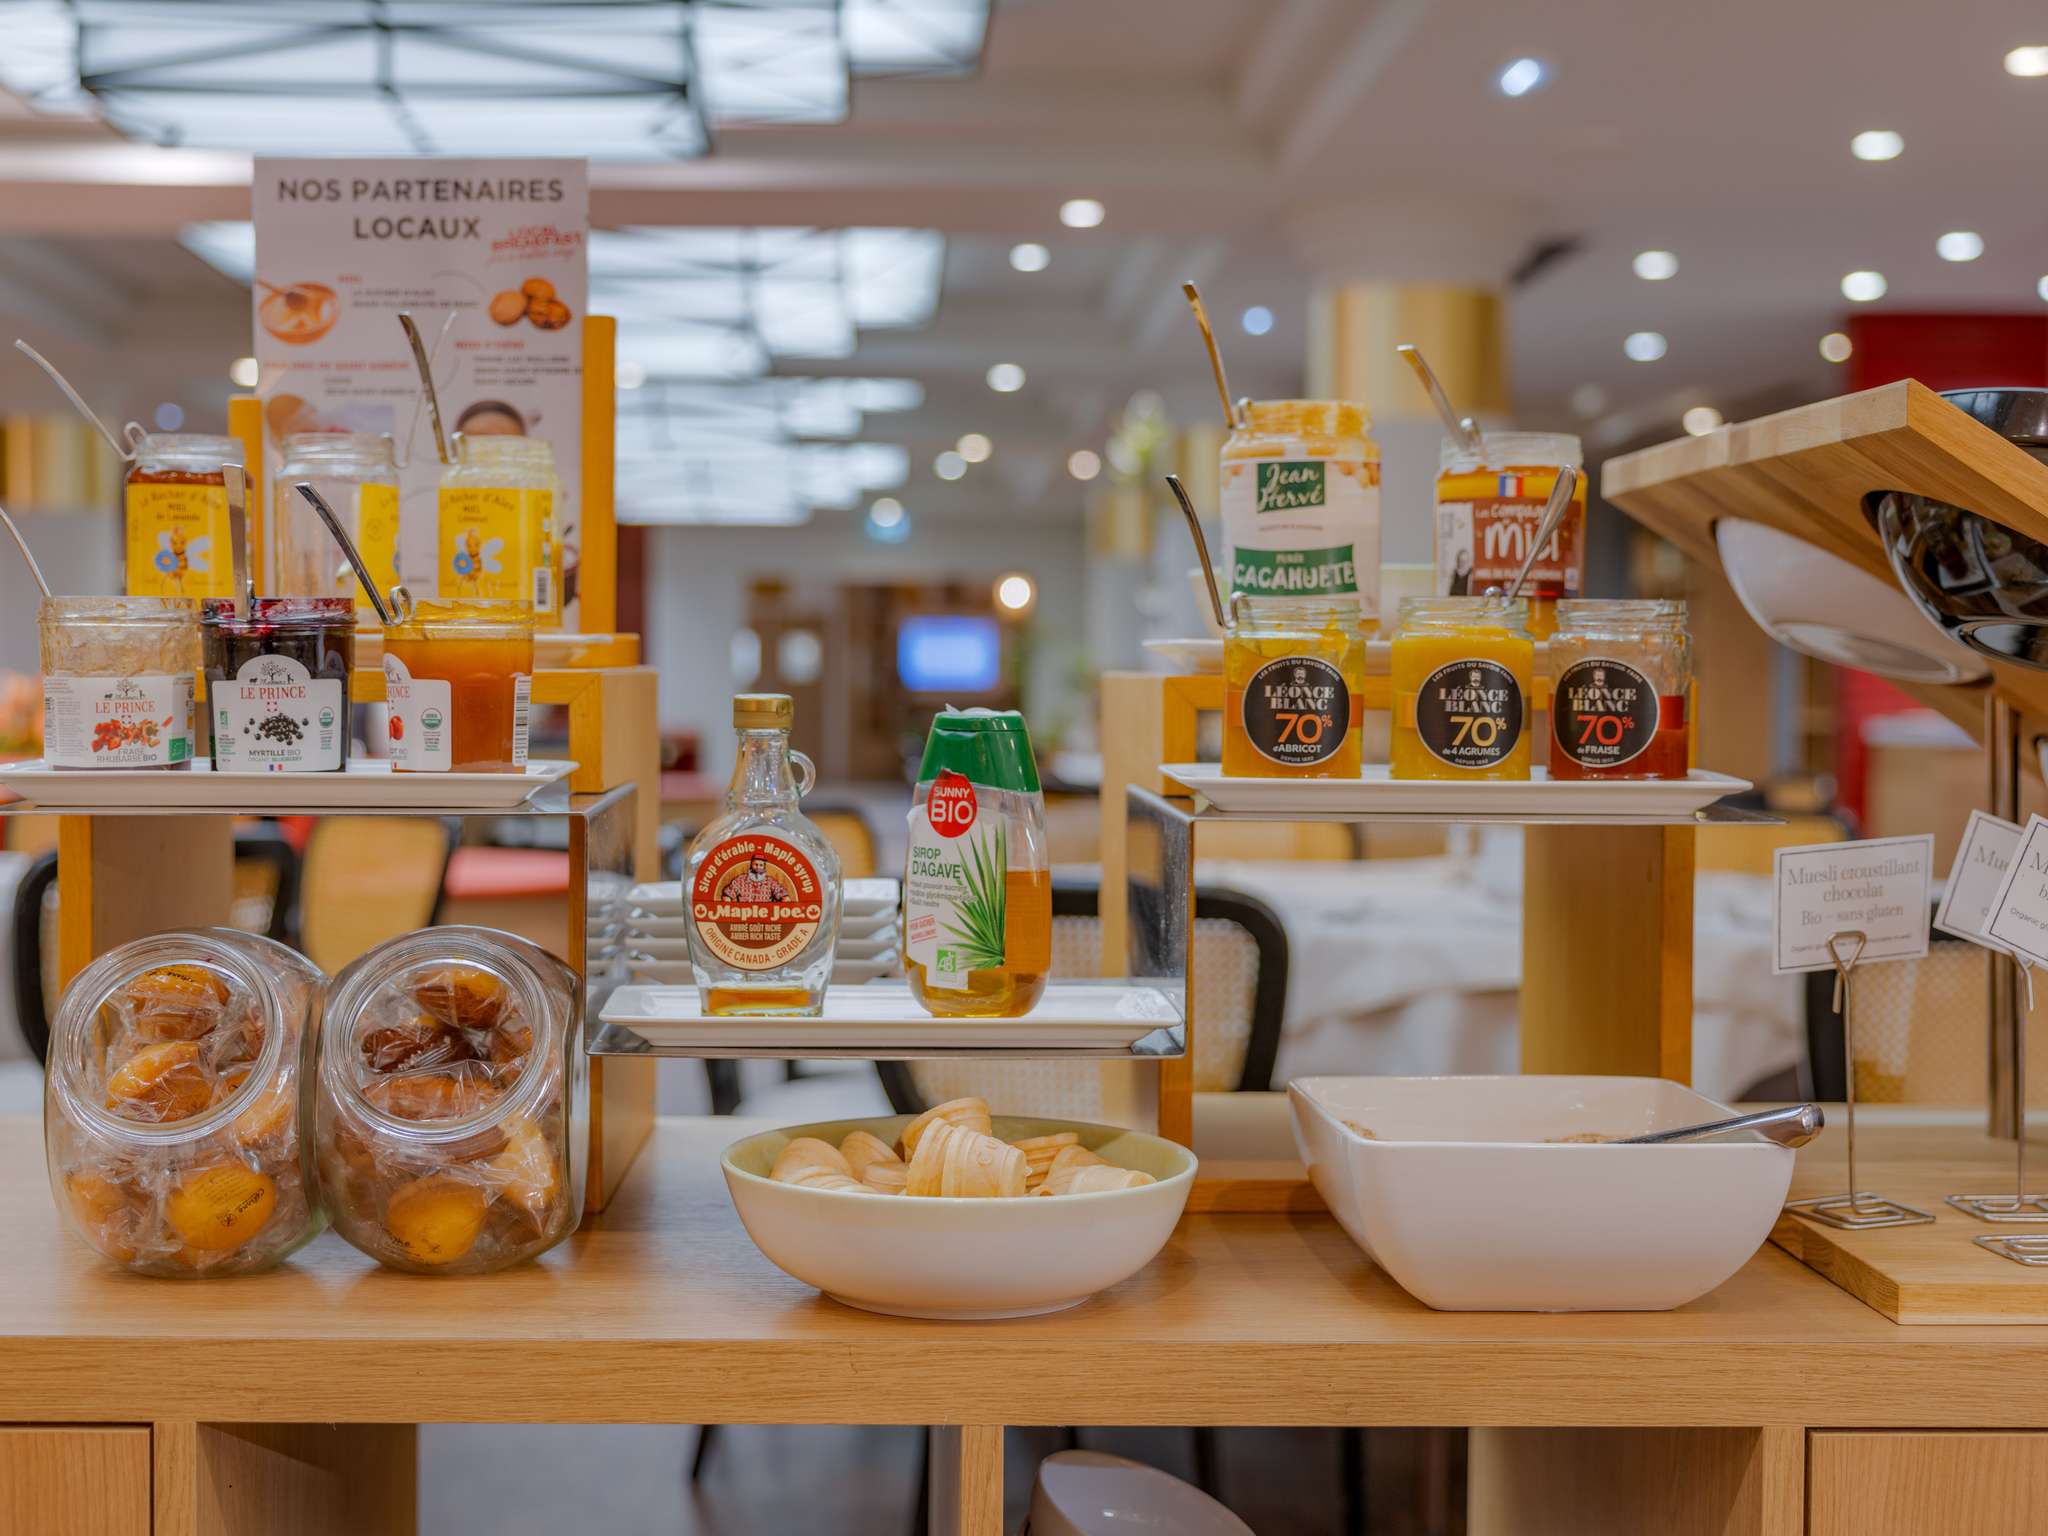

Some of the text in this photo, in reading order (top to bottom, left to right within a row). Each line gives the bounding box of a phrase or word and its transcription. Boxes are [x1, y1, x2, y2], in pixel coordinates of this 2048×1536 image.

[277, 178, 564, 203] NOS PARTENAIRES
[353, 217, 480, 240] LOCAUX
[1266, 463, 1319, 493] Jean
[1258, 484, 1322, 513] Hervé
[241, 685, 306, 700] LE PRINCE
[1264, 683, 1335, 699] LÉONCE
[1438, 685, 1509, 702] LÉONCE
[1568, 685, 1637, 701] LÉONCE
[95, 700, 156, 714] LE PRINCE
[1270, 697, 1328, 710] BLANC
[1445, 700, 1502, 713] BLANC
[1572, 699, 1629, 713] BLANC
[1275, 713, 1333, 744] 70%
[1450, 715, 1507, 747] 70%
[1577, 714, 1634, 746] 70%
[142, 753, 157, 761] BIO
[248, 749, 285, 757] MYRTILLE
[1458, 747, 1501, 756] AGRUMES
[1585, 745, 1620, 755] FRAISE
[935, 786, 970, 798] SUNNY
[931, 799, 974, 825] BIO
[912, 845, 941, 860] SIROP
[698, 864, 718, 893] Sirop
[714, 841, 755, 866] d'érable
[763, 842, 795, 865] Maple
[793, 863, 814, 894] syrup
[912, 860, 961, 880] D'AGAVE
[1788, 857, 1919, 886] Muesli croustillant
[1823, 881, 1884, 902] chocolat
[707, 904, 769, 921] Maple
[1801, 910, 1822, 926] Bio
[1838, 909, 1863, 922] sans
[1866, 903, 1904, 924] gluten
[706, 927, 734, 957] ORIGINE
[734, 951, 770, 964] CANADA
[775, 936, 803, 959] GRADE
[800, 928, 809, 937] A
